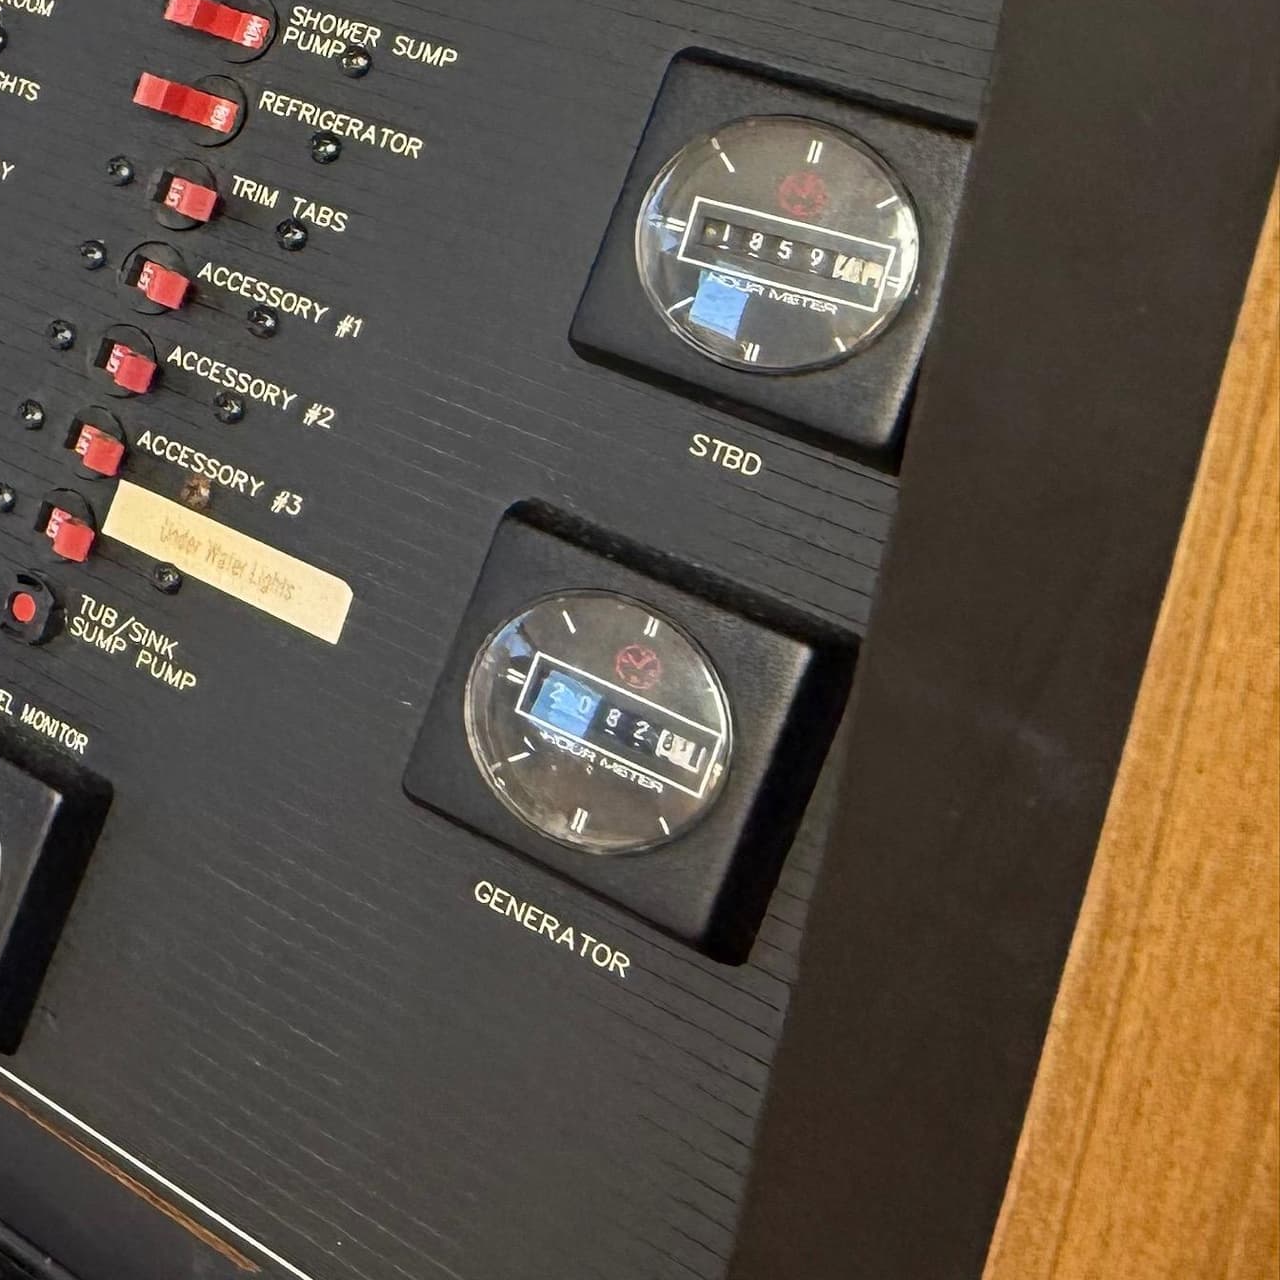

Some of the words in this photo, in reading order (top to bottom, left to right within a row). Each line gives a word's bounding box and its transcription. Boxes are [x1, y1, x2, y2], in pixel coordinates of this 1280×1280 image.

[282, 26, 346, 59] PUMP
[289, 5, 383, 48] SHOWER
[391, 35, 458, 69] SUMP
[258, 90, 424, 160] REFRIGERATOR
[231, 174, 281, 209] TRIM
[291, 196, 350, 233] TABS
[196, 261, 330, 324] ACCESSORY
[334, 314, 364, 339] #1
[166, 345, 299, 411] ACCESSORY
[302, 402, 336, 430] #2
[137, 429, 265, 498] ACCESSORY
[270, 489, 304, 516] #3
[689, 433, 763, 477] STBD
[70, 616, 128, 656] SUMP
[136, 649, 197, 692] PUMP
[79, 593, 179, 661] TUB/SINK
[19, 704, 90, 754] MONITOR
[474, 880, 632, 978] GENERATOR
